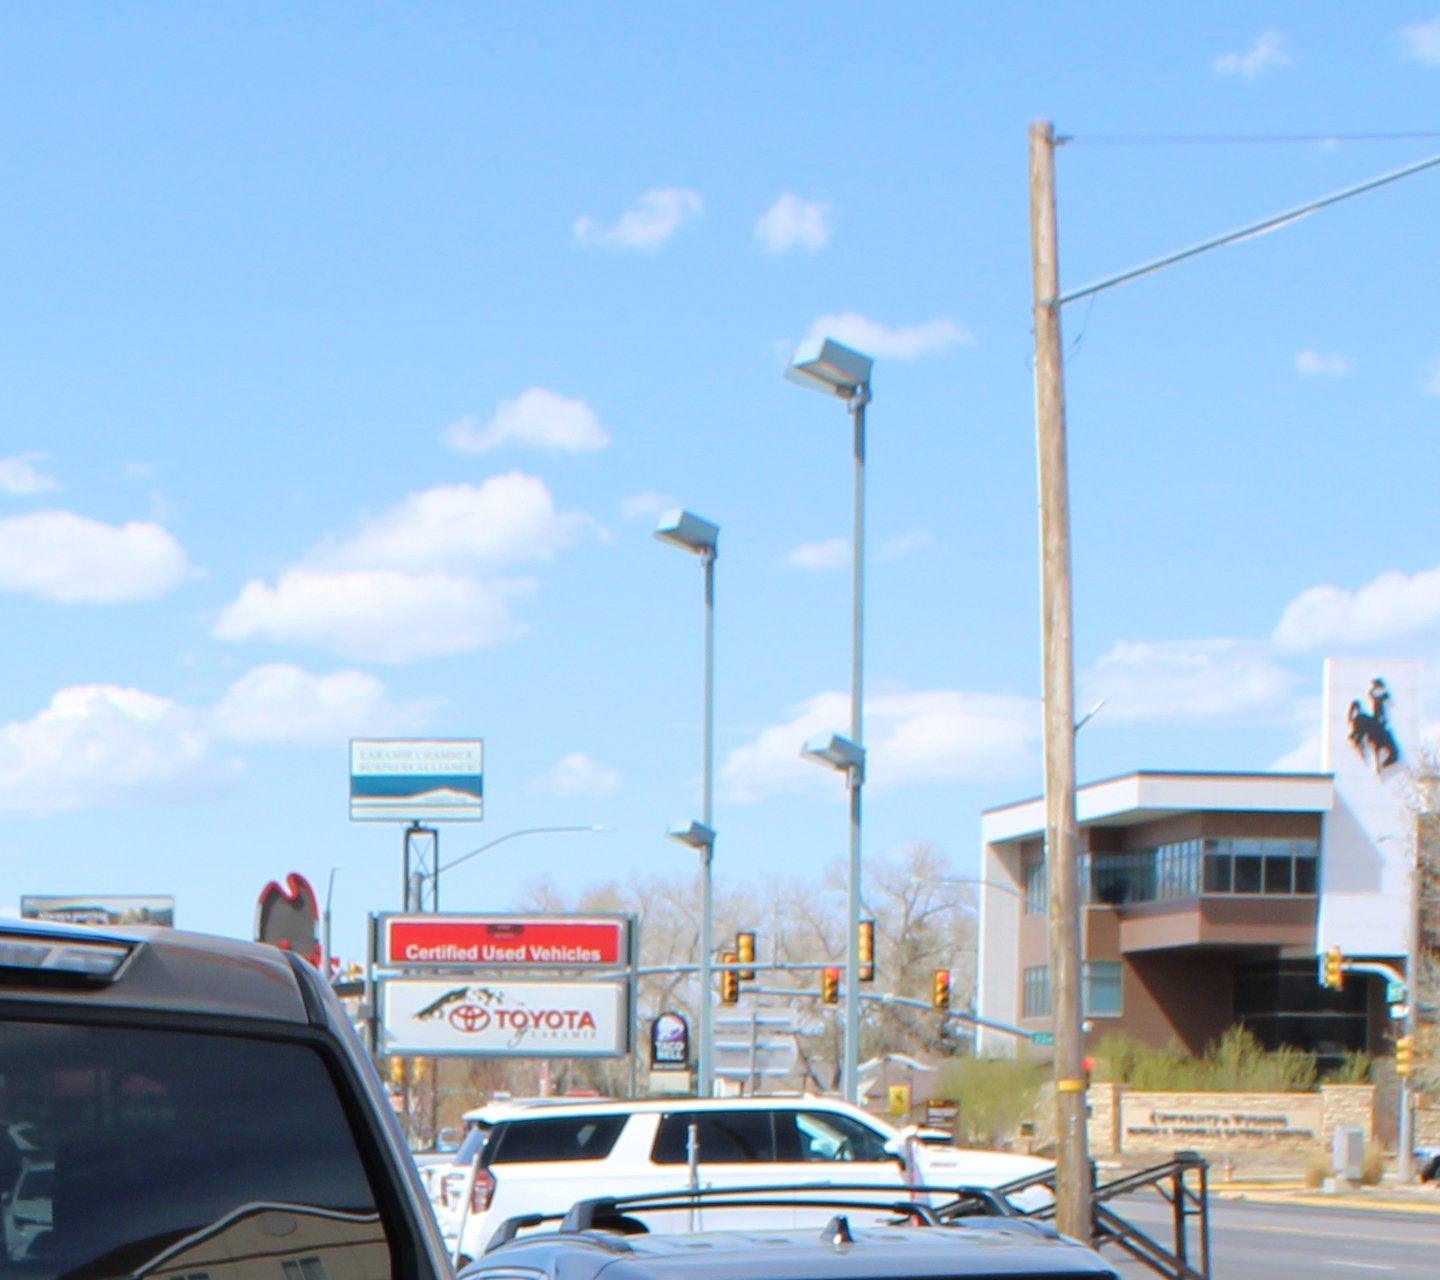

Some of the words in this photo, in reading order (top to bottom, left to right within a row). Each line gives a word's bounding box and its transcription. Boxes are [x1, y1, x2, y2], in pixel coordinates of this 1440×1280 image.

[405, 944, 478, 961] Certified
[482, 945, 527, 961] Used
[530, 945, 601, 961] Vehicles
[493, 1009, 597, 1030] TOYOTA
